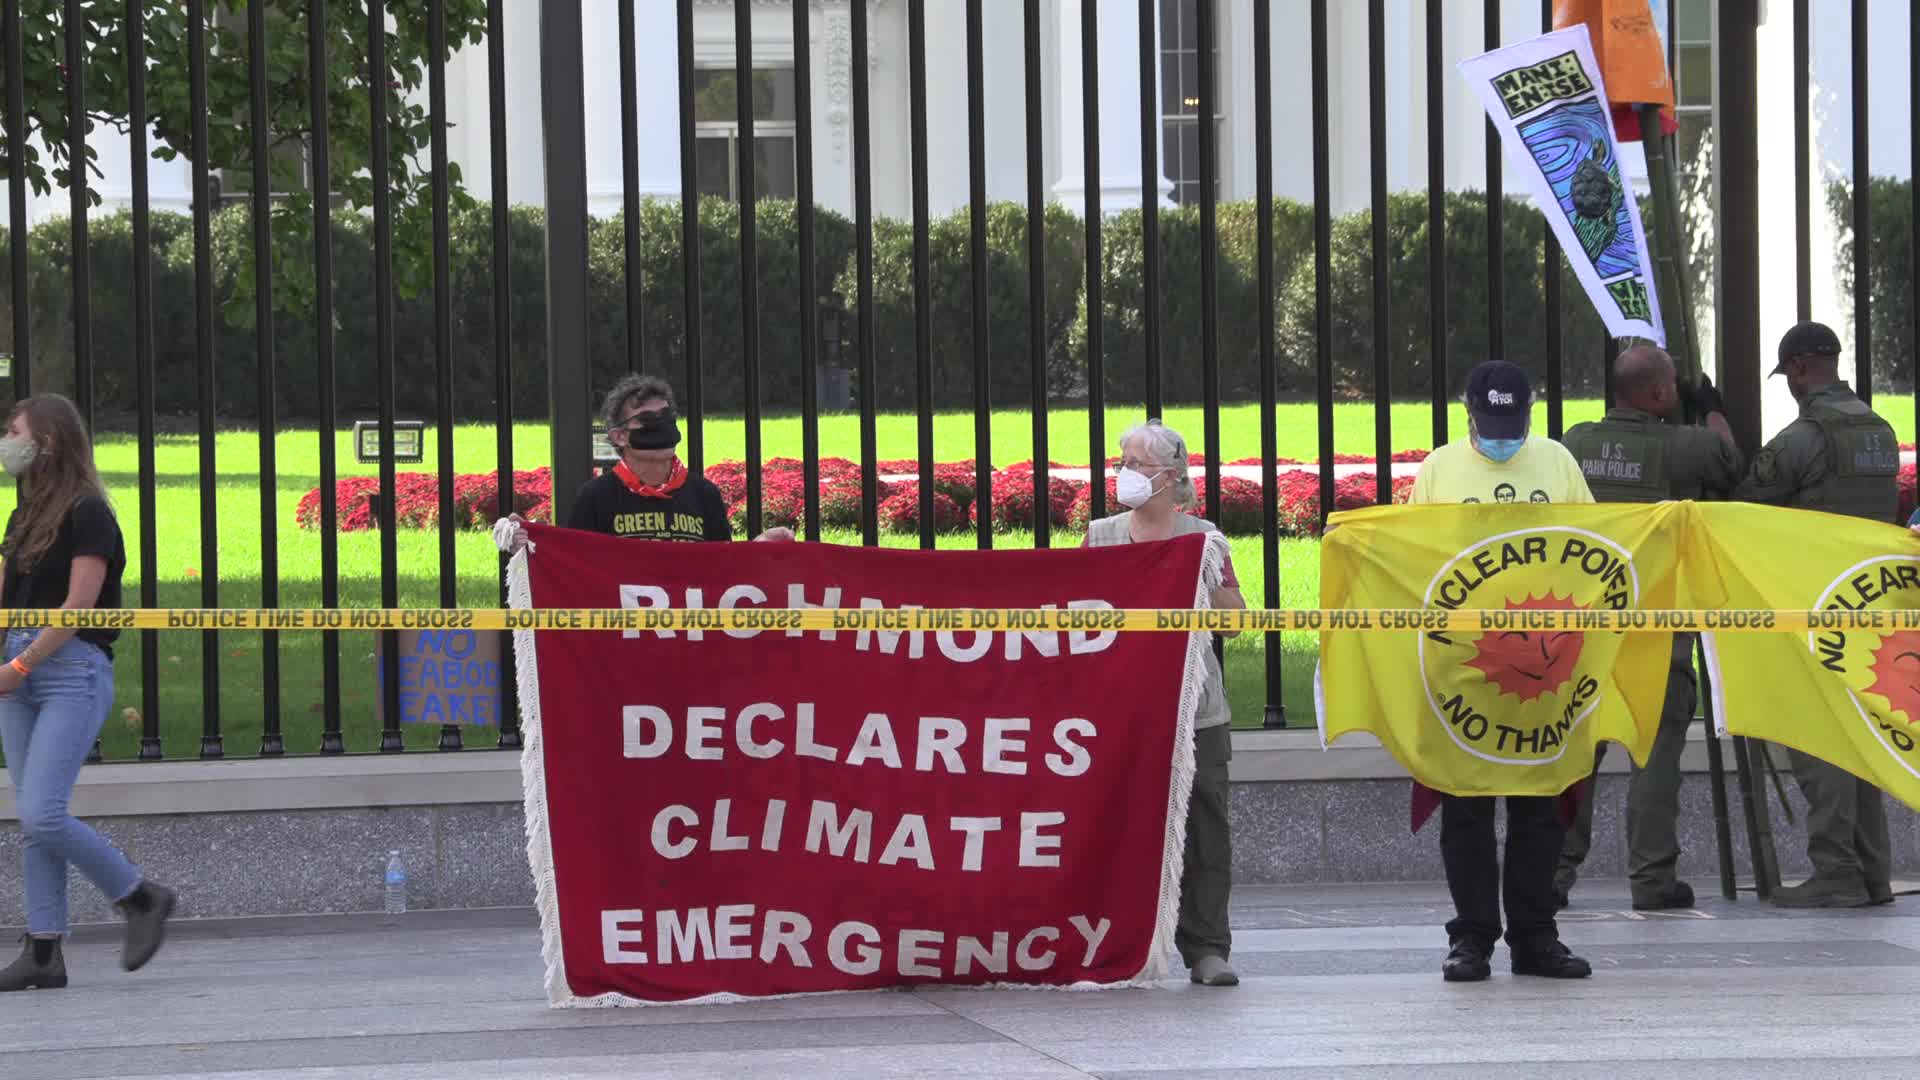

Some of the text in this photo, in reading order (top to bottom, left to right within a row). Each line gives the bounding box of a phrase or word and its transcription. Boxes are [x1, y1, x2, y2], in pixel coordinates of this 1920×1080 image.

[1583, 458, 1641, 479] PARK POLICE
[614, 512, 704, 535] GREEN JOBS
[415, 629, 476, 660] NO
[618, 583, 1119, 662] RICHMOND
[379, 656, 500, 689] EABOD
[398, 691, 501, 727] EAKE
[1442, 675, 1598, 753] NO THANKS
[621, 702, 1098, 777] DECLARES
[650, 798, 1066, 872] CLIMATE
[600, 903, 1112, 978] EMERGENCY
